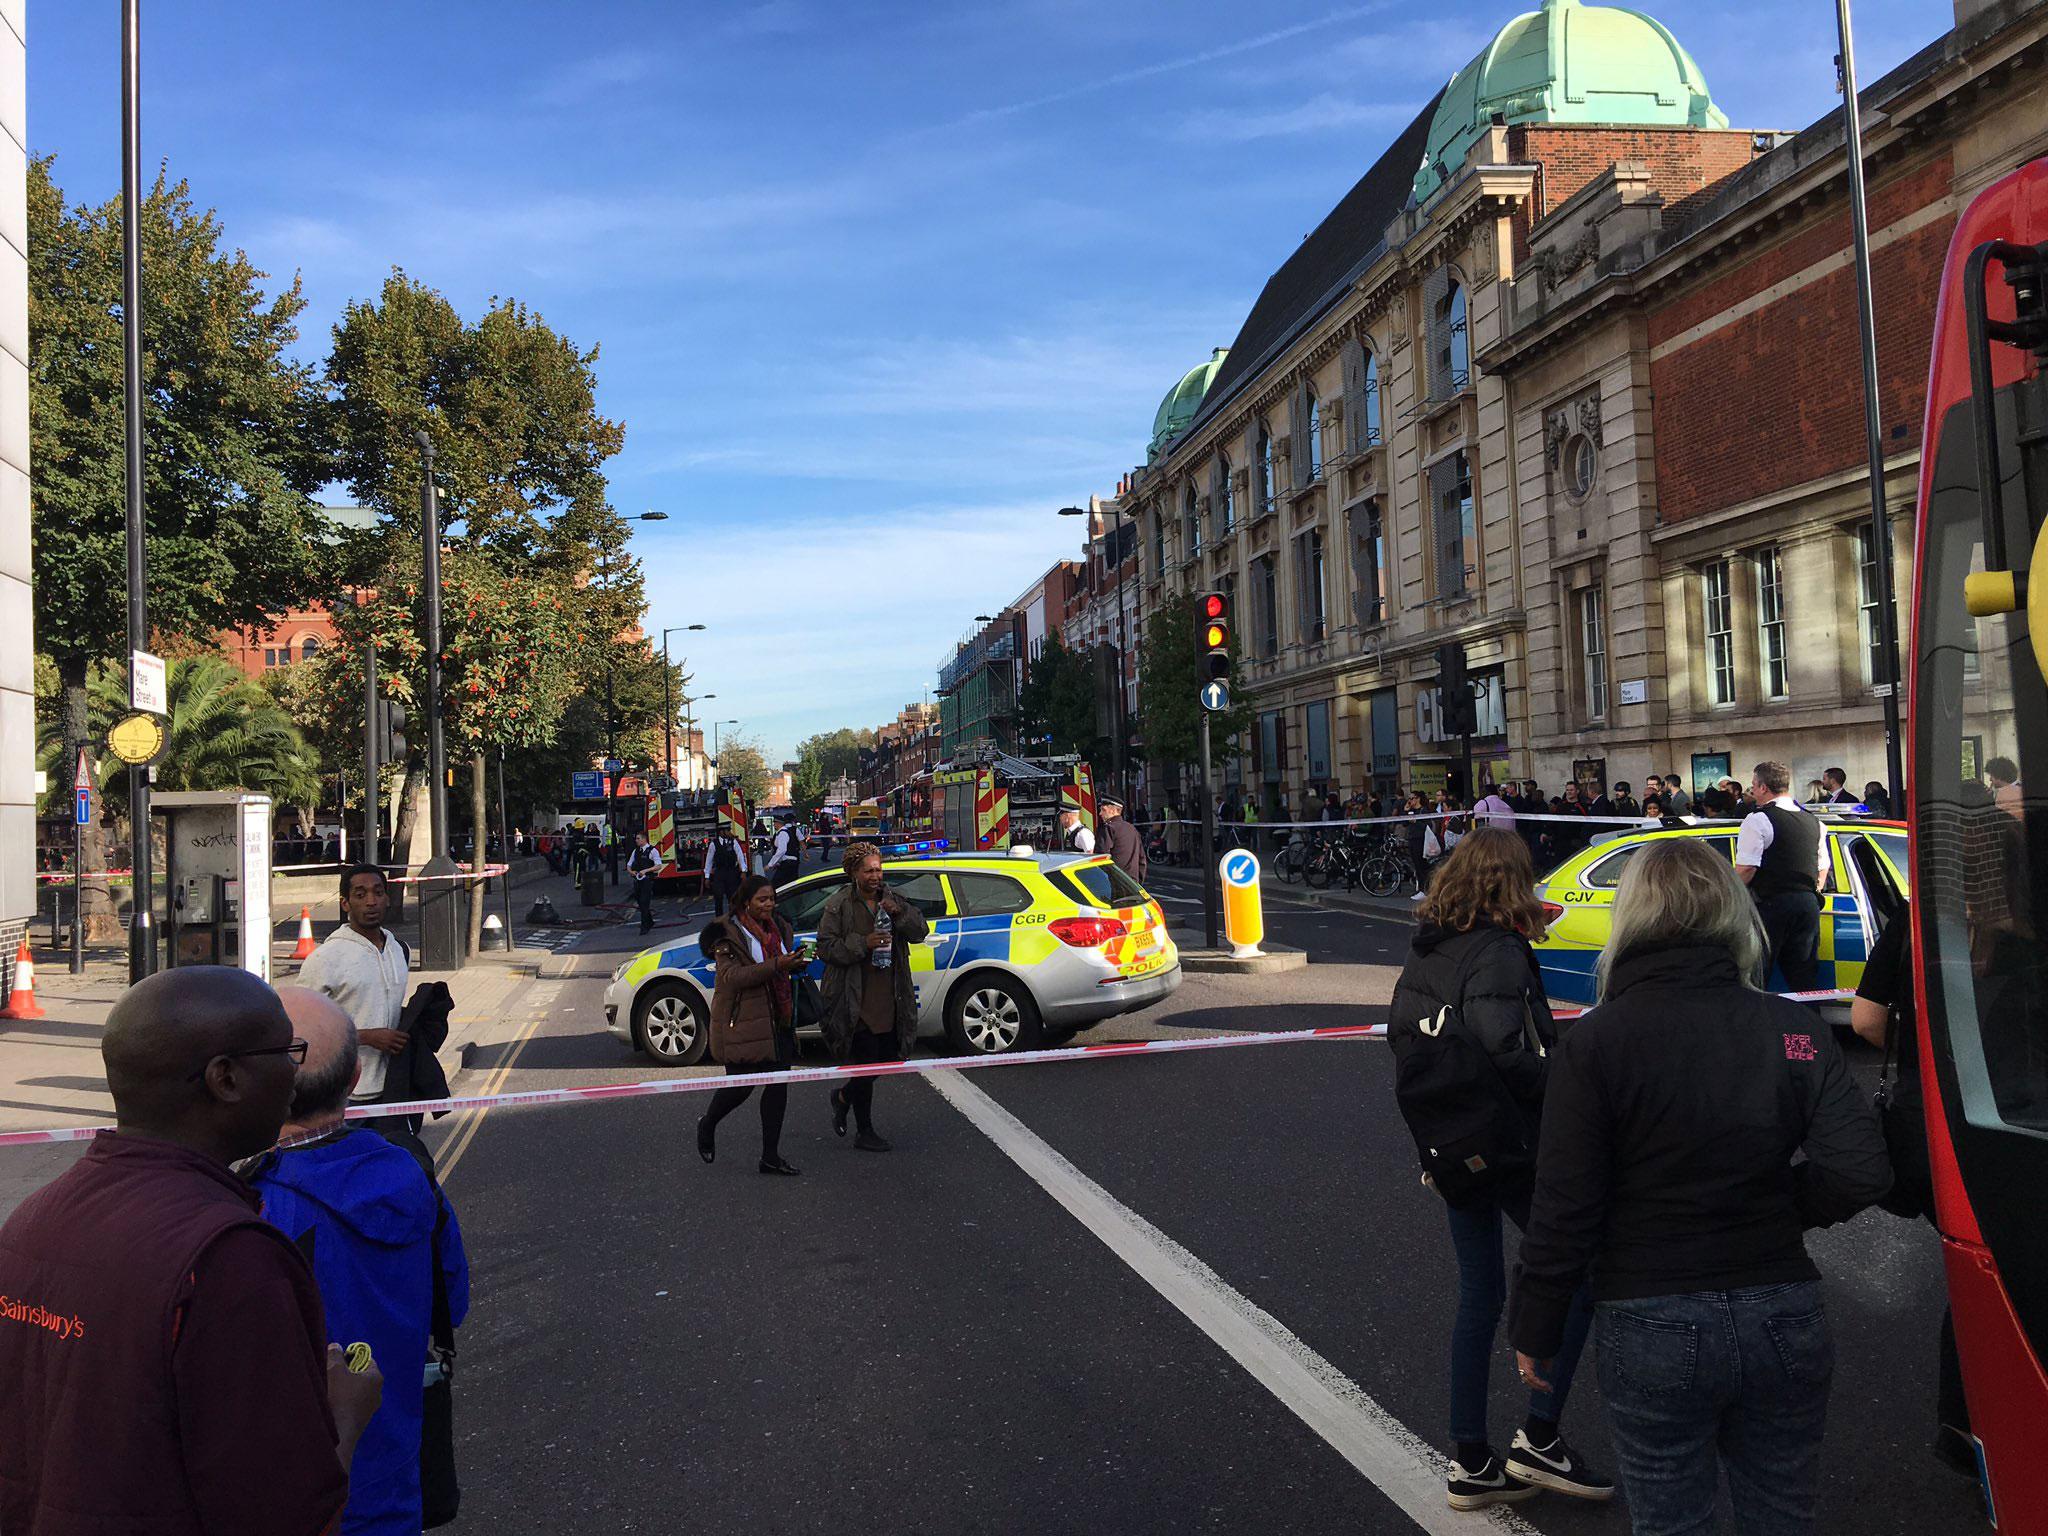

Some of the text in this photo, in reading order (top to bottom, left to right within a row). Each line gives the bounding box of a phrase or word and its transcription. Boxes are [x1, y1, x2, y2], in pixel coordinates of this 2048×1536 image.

[135, 668, 148, 686] Mare
[135, 687, 152, 705] Street
[1416, 676, 1506, 743] CIMA
[1564, 891, 1594, 902] CJV
[1015, 914, 1047, 925] CGB
[1122, 955, 1163, 975] POLIC
[0, 1295, 85, 1340] Sainsbury's
